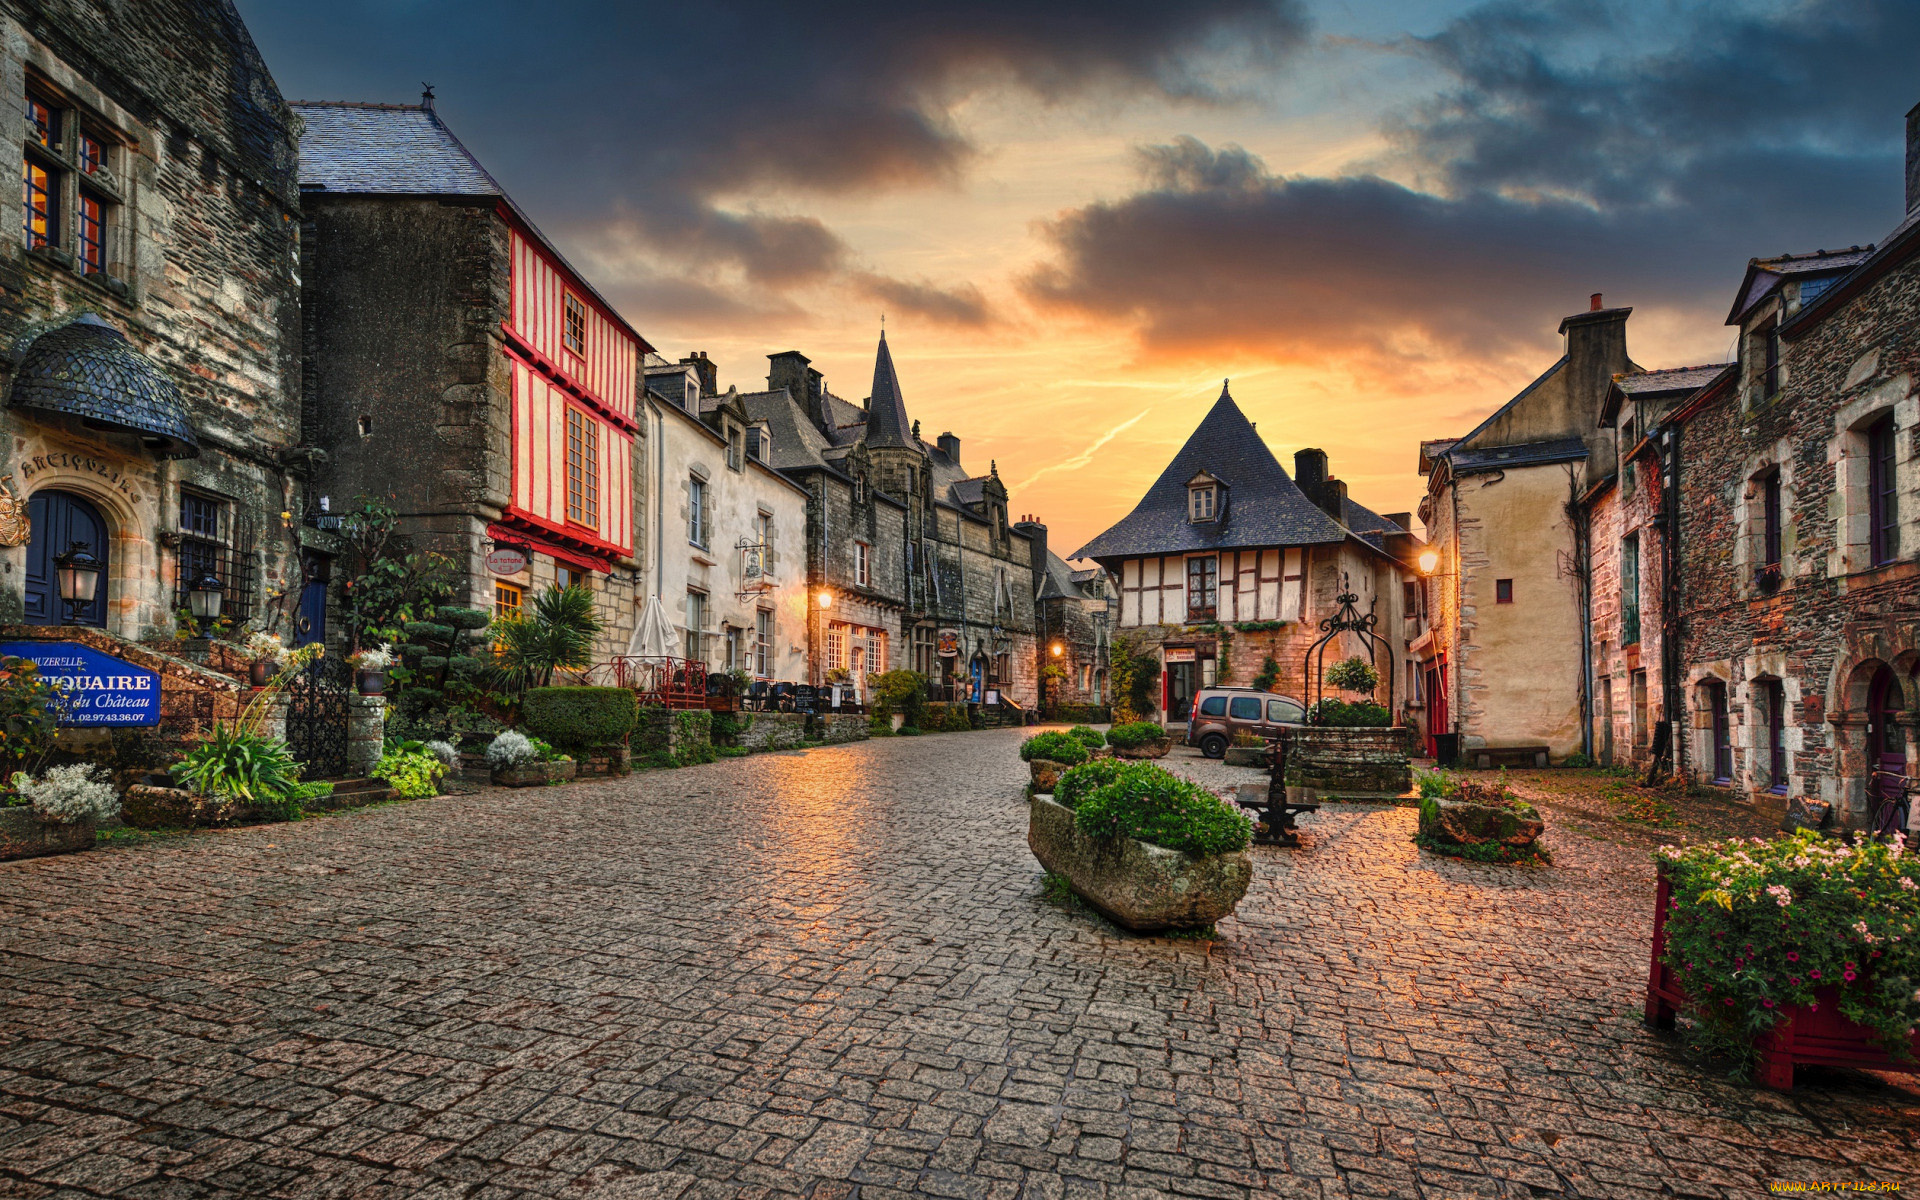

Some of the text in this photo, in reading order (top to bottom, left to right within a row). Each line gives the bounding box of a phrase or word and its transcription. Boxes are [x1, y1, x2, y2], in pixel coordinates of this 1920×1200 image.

[33, 676, 151, 690] TIQUAIRE
[73, 694, 90, 708] du
[95, 694, 150, 708] Château
